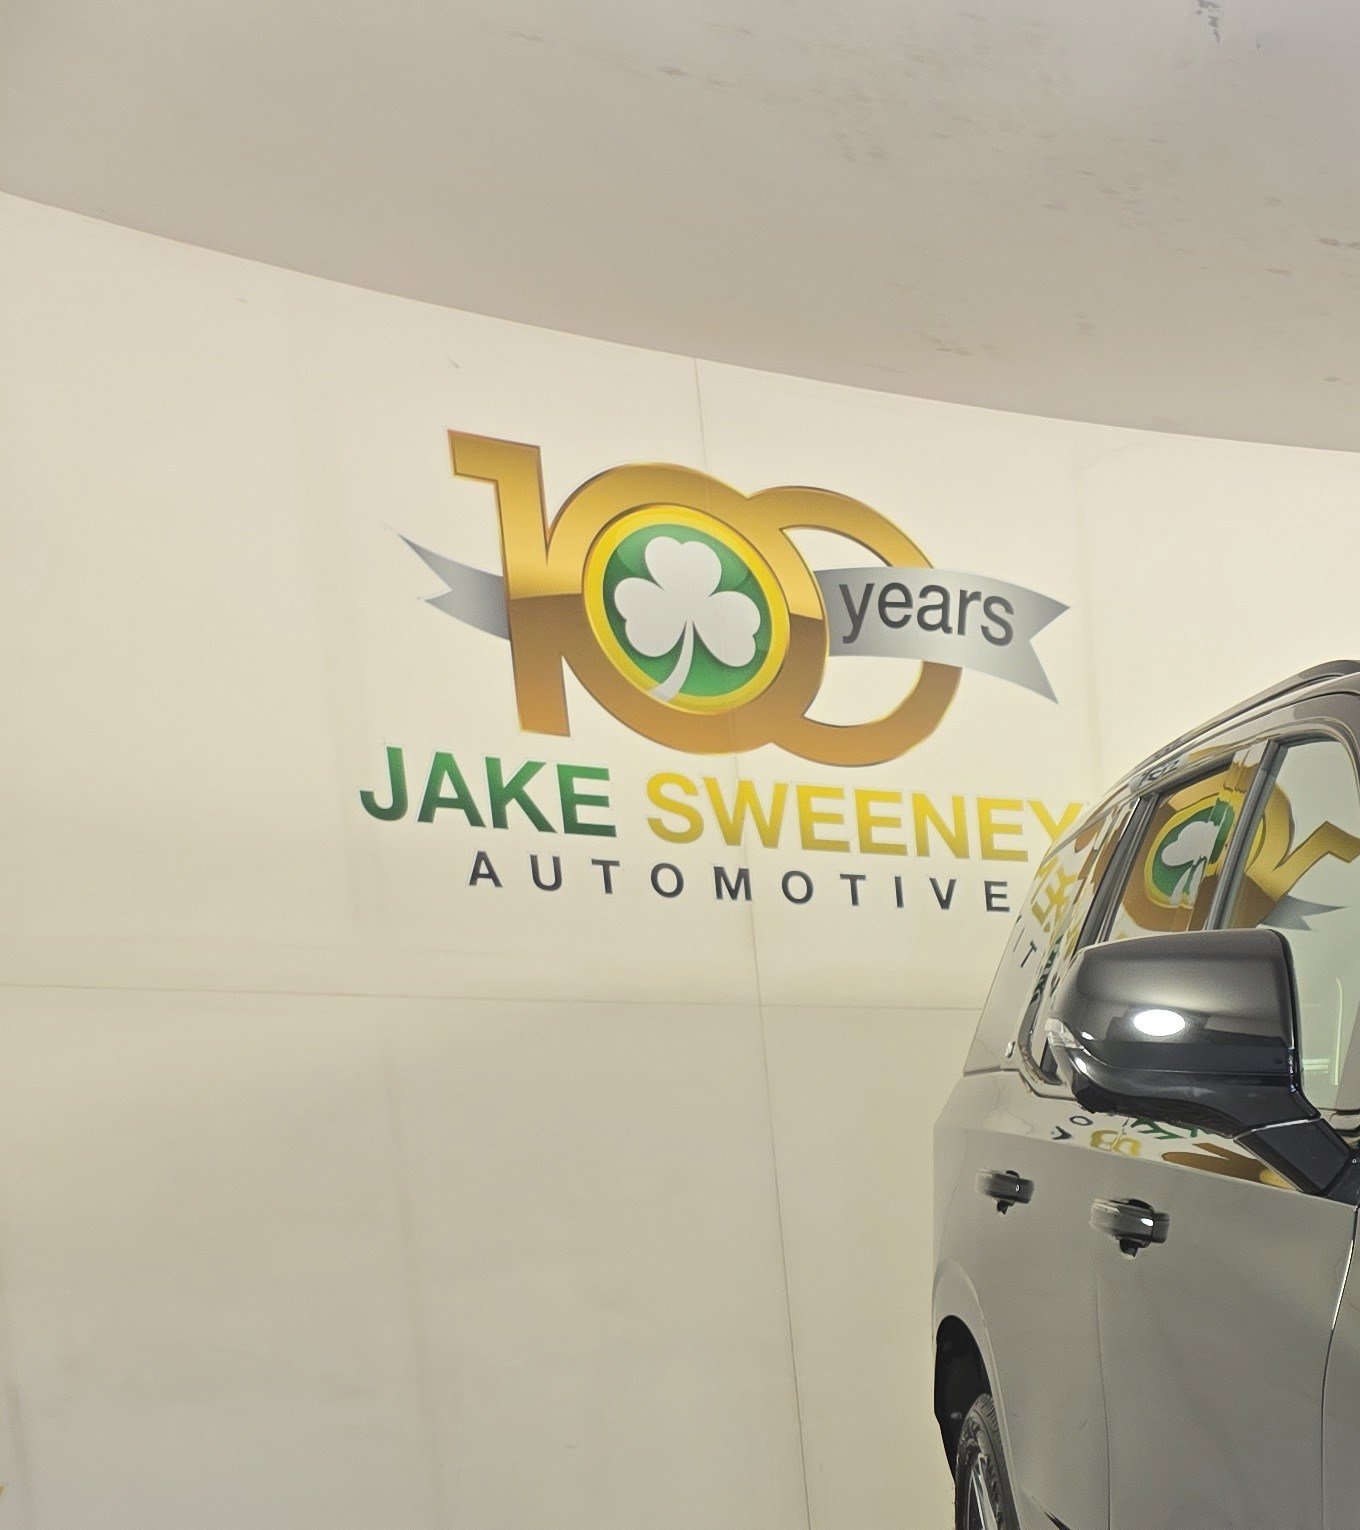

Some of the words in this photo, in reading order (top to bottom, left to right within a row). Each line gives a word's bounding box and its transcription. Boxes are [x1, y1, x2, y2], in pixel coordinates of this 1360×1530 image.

[839, 582, 1016, 645] years
[359, 746, 616, 838] JAKE
[646, 772, 1084, 862] SWEENEY
[468, 850, 1010, 912] AUTOMOTIVE
